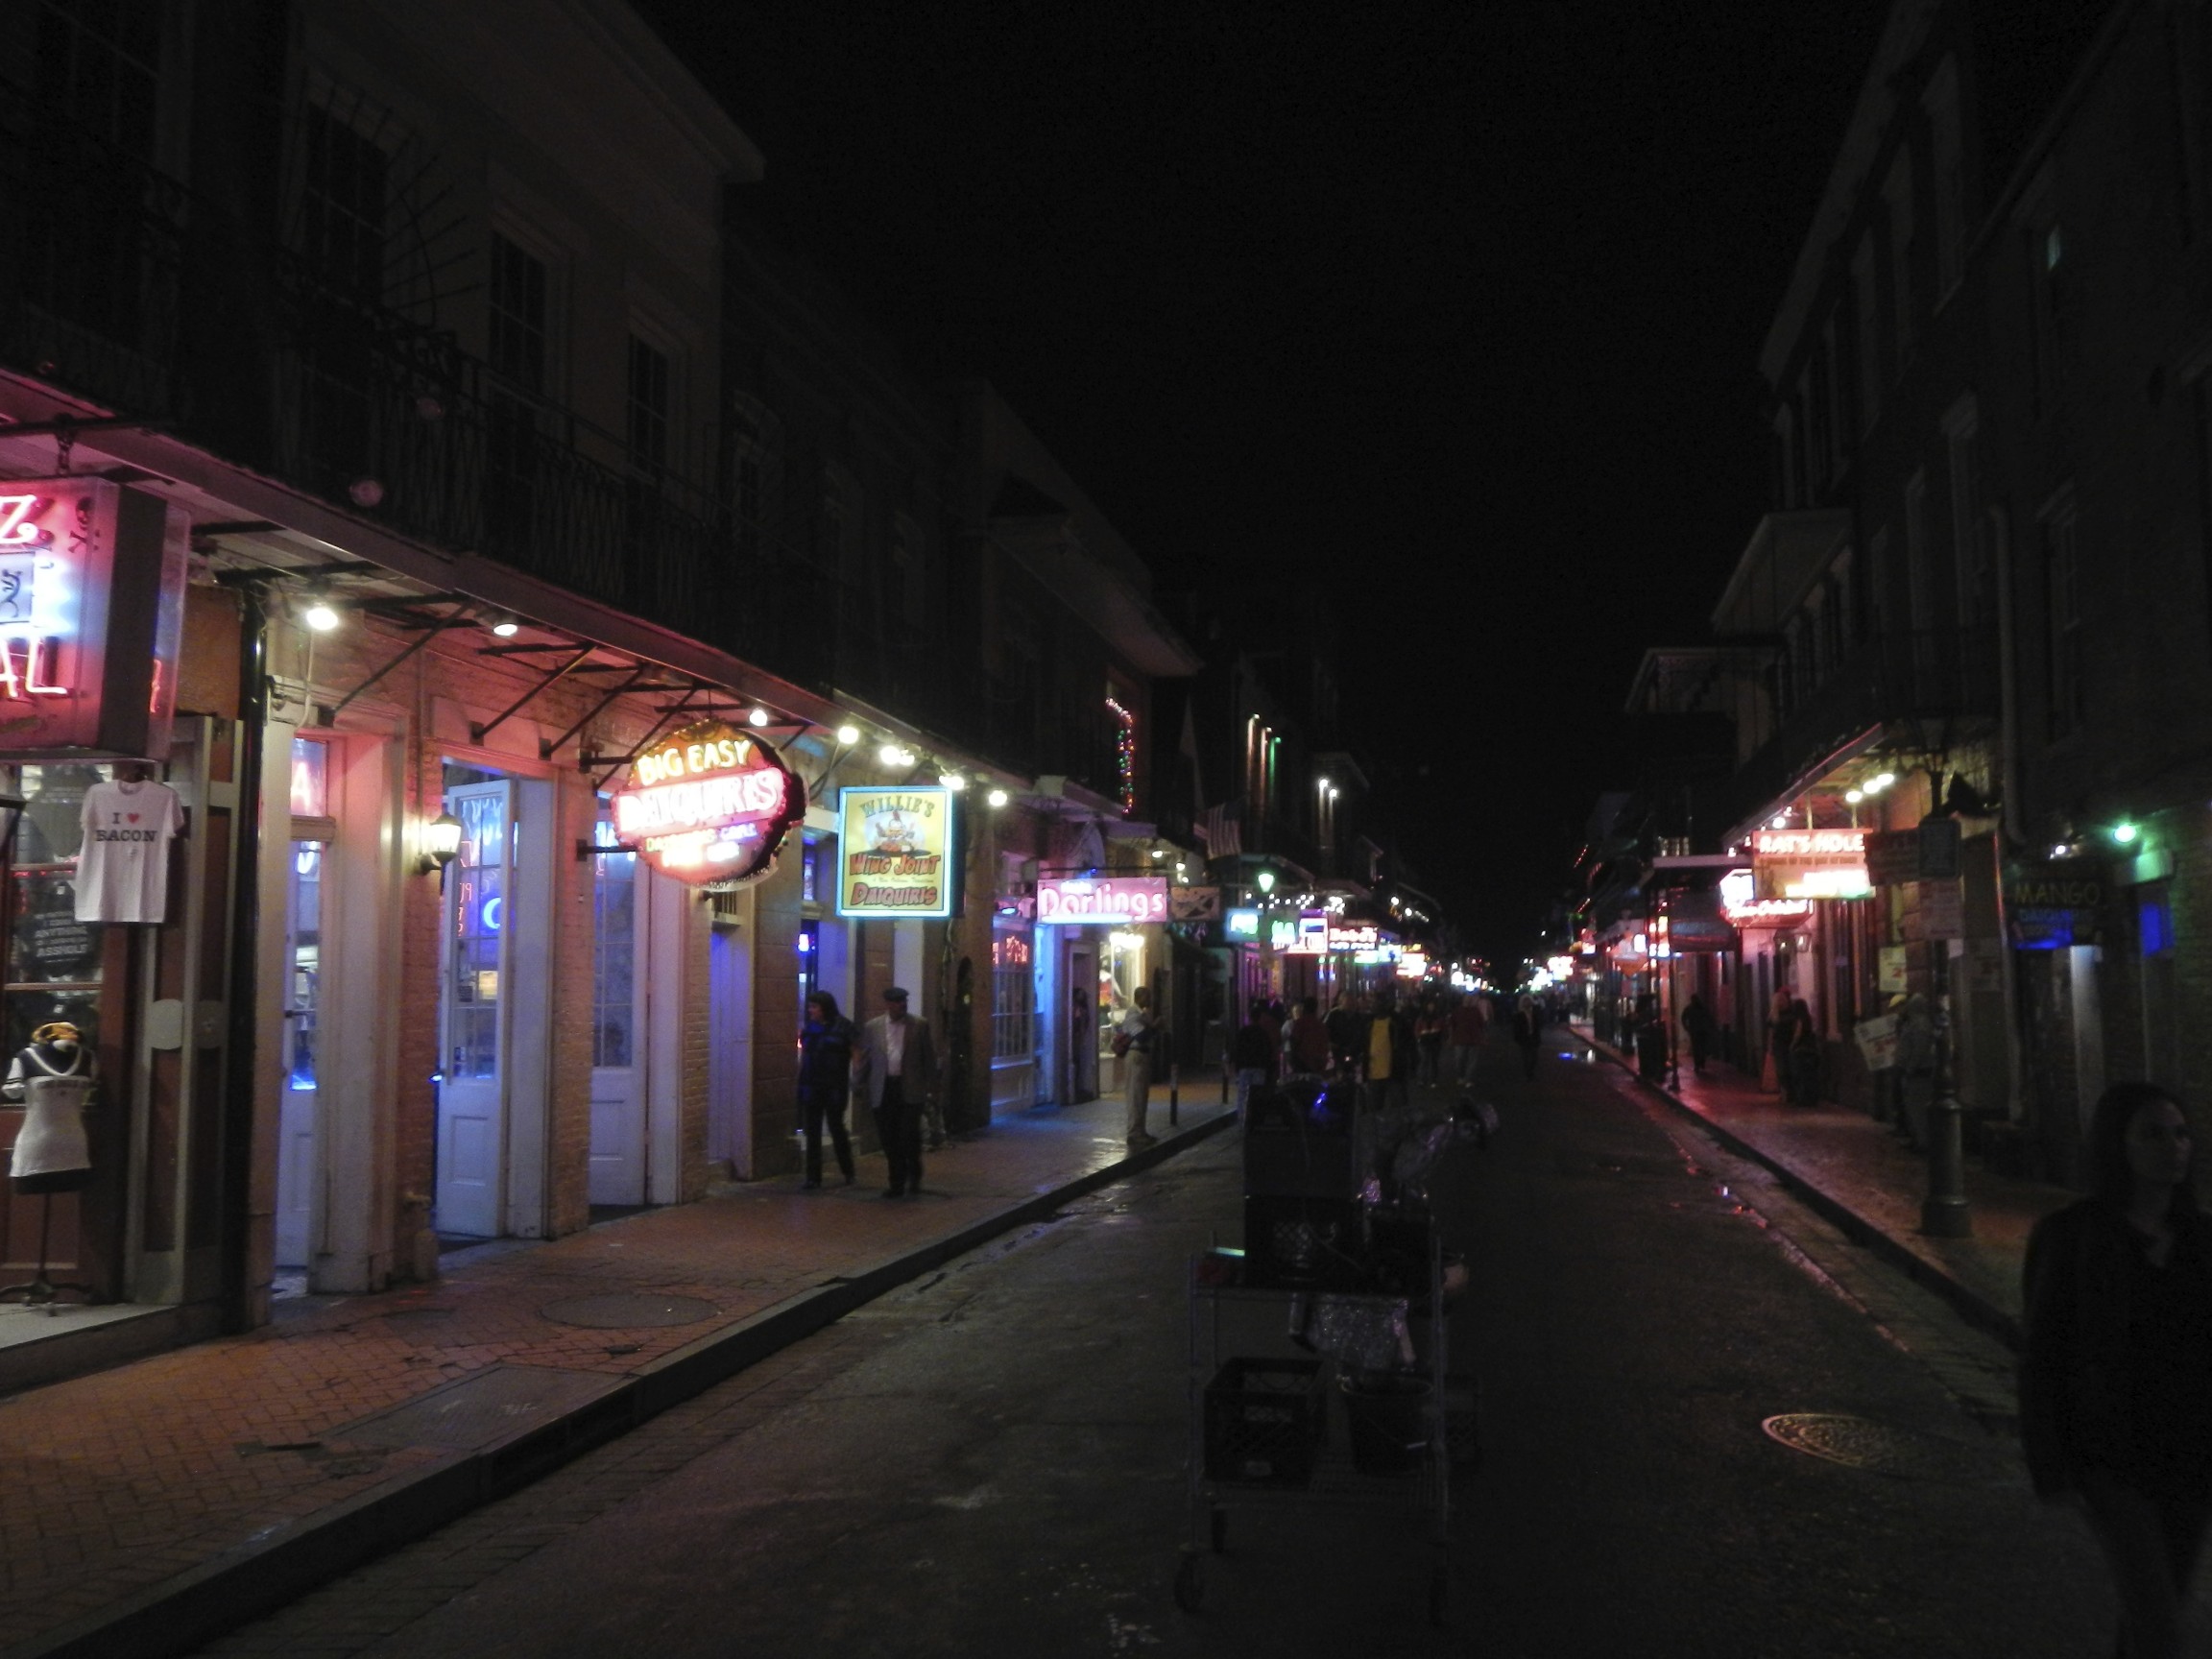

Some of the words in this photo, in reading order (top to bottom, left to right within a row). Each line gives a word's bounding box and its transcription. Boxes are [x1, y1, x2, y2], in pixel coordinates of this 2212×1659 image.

[637, 748, 685, 785] BIG
[687, 739, 752, 773] EASY
[859, 794, 935, 818] WILLIE'S
[112, 812, 120, 825] I
[96, 830, 157, 843] BACON
[1759, 834, 1811, 853] RAT'S
[1815, 833, 1865, 853] HOLE
[849, 852, 892, 876] WING
[893, 854, 942, 876] JOINT
[850, 881, 938, 907] DAIQUIRIS
[1041, 882, 1164, 921] Darlings
[2014, 881, 2101, 905] MANGO
